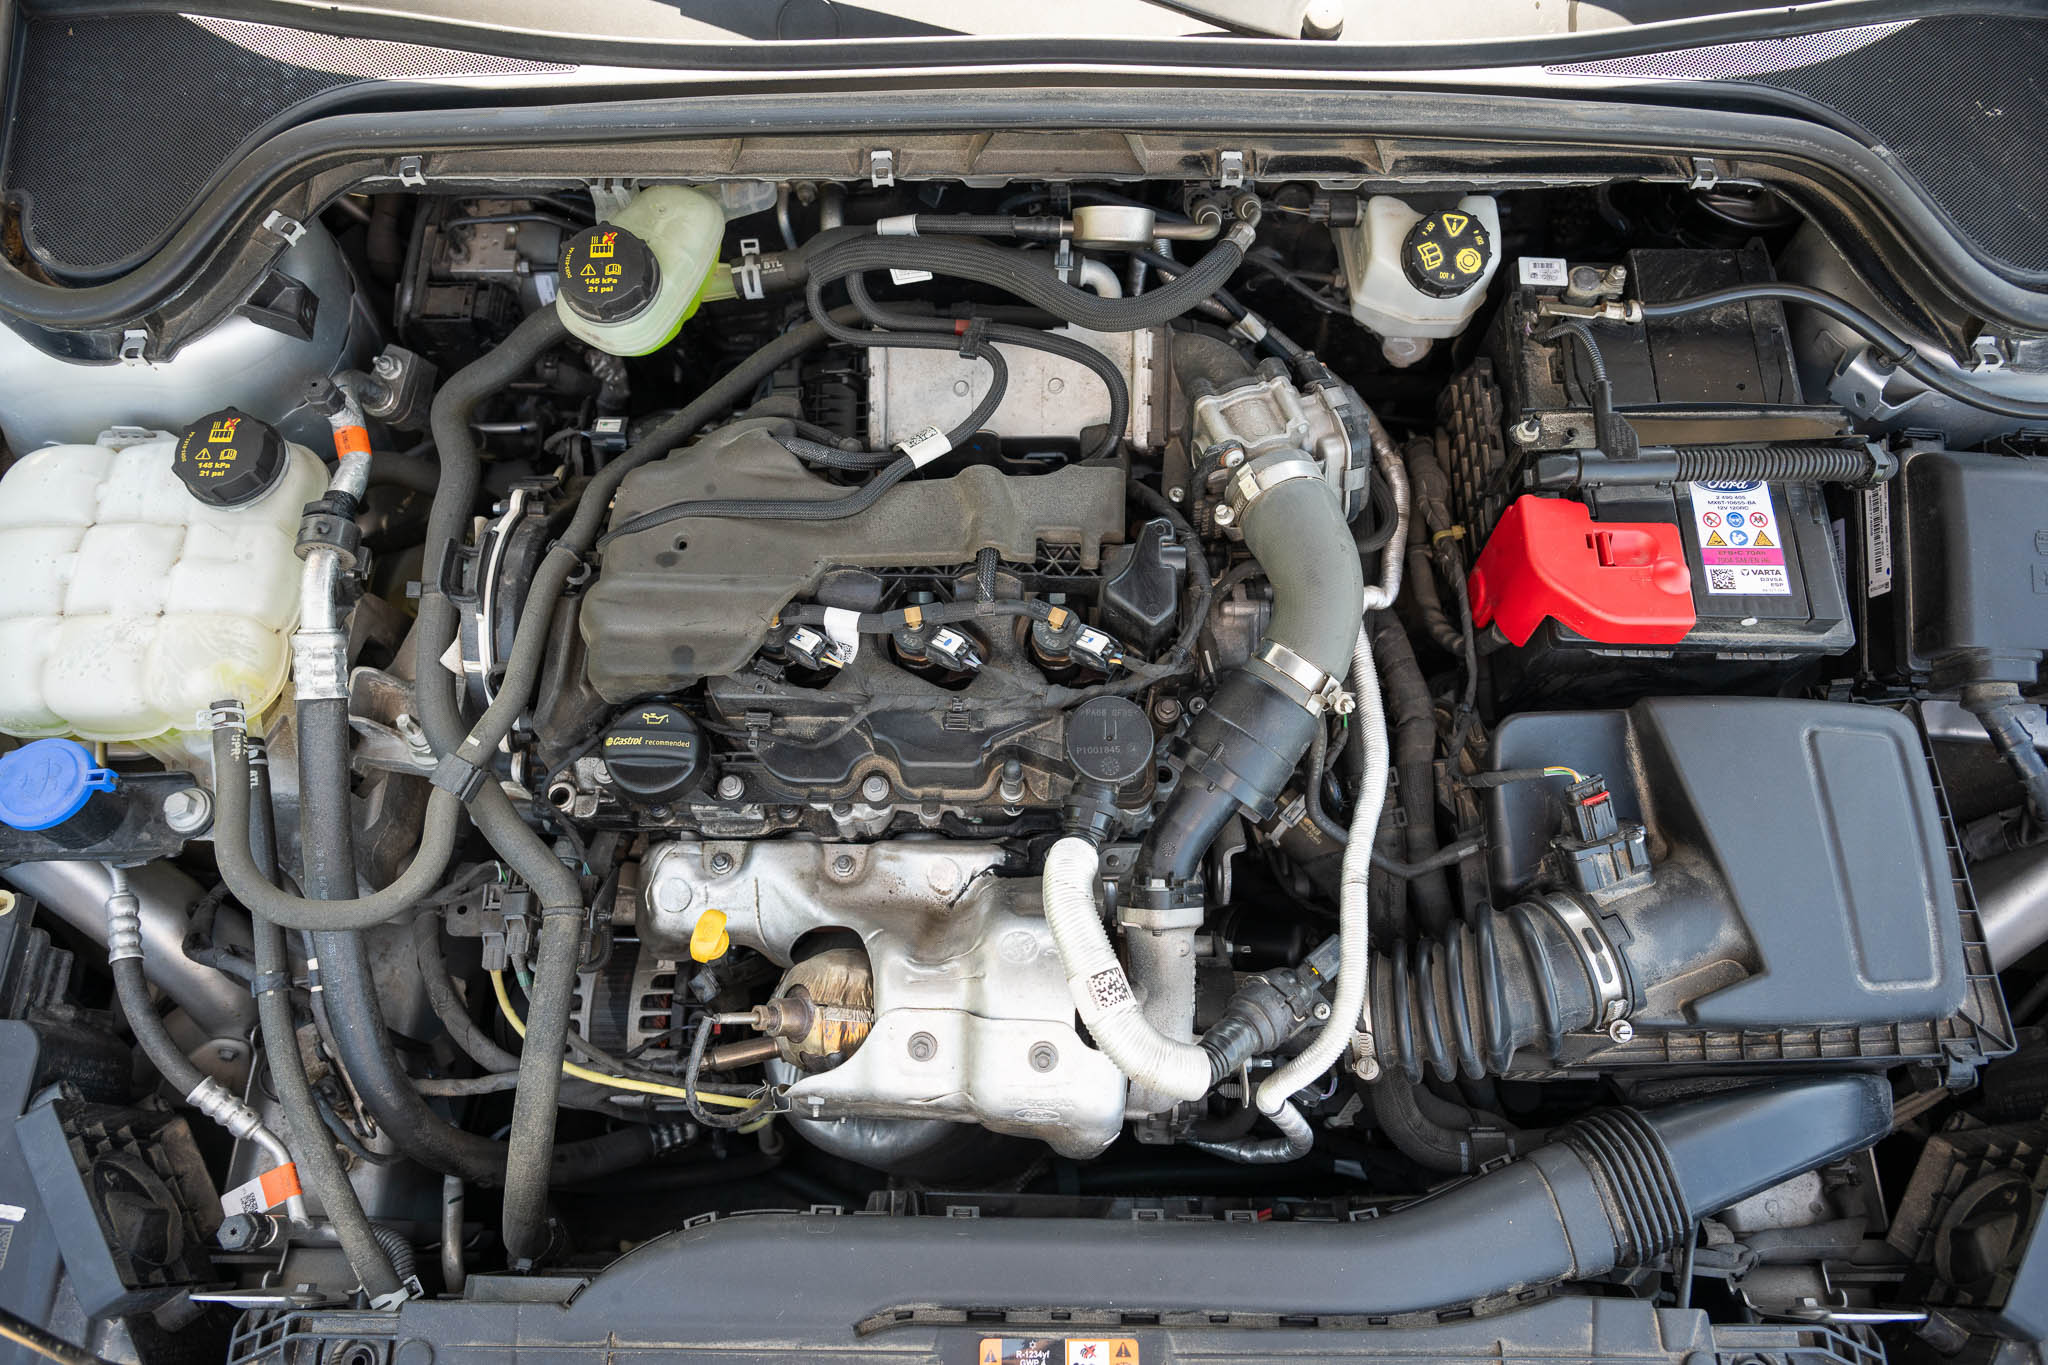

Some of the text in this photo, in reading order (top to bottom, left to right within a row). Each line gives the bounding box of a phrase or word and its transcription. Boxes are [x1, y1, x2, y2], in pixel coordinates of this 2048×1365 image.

[584, 277, 600, 285] 145
[600, 286, 614, 294] psi
[211, 470, 225, 478] psi
[612, 736, 690, 748] Castrol recommended
[1016, 1349, 1050, 1359] R-1234yf
